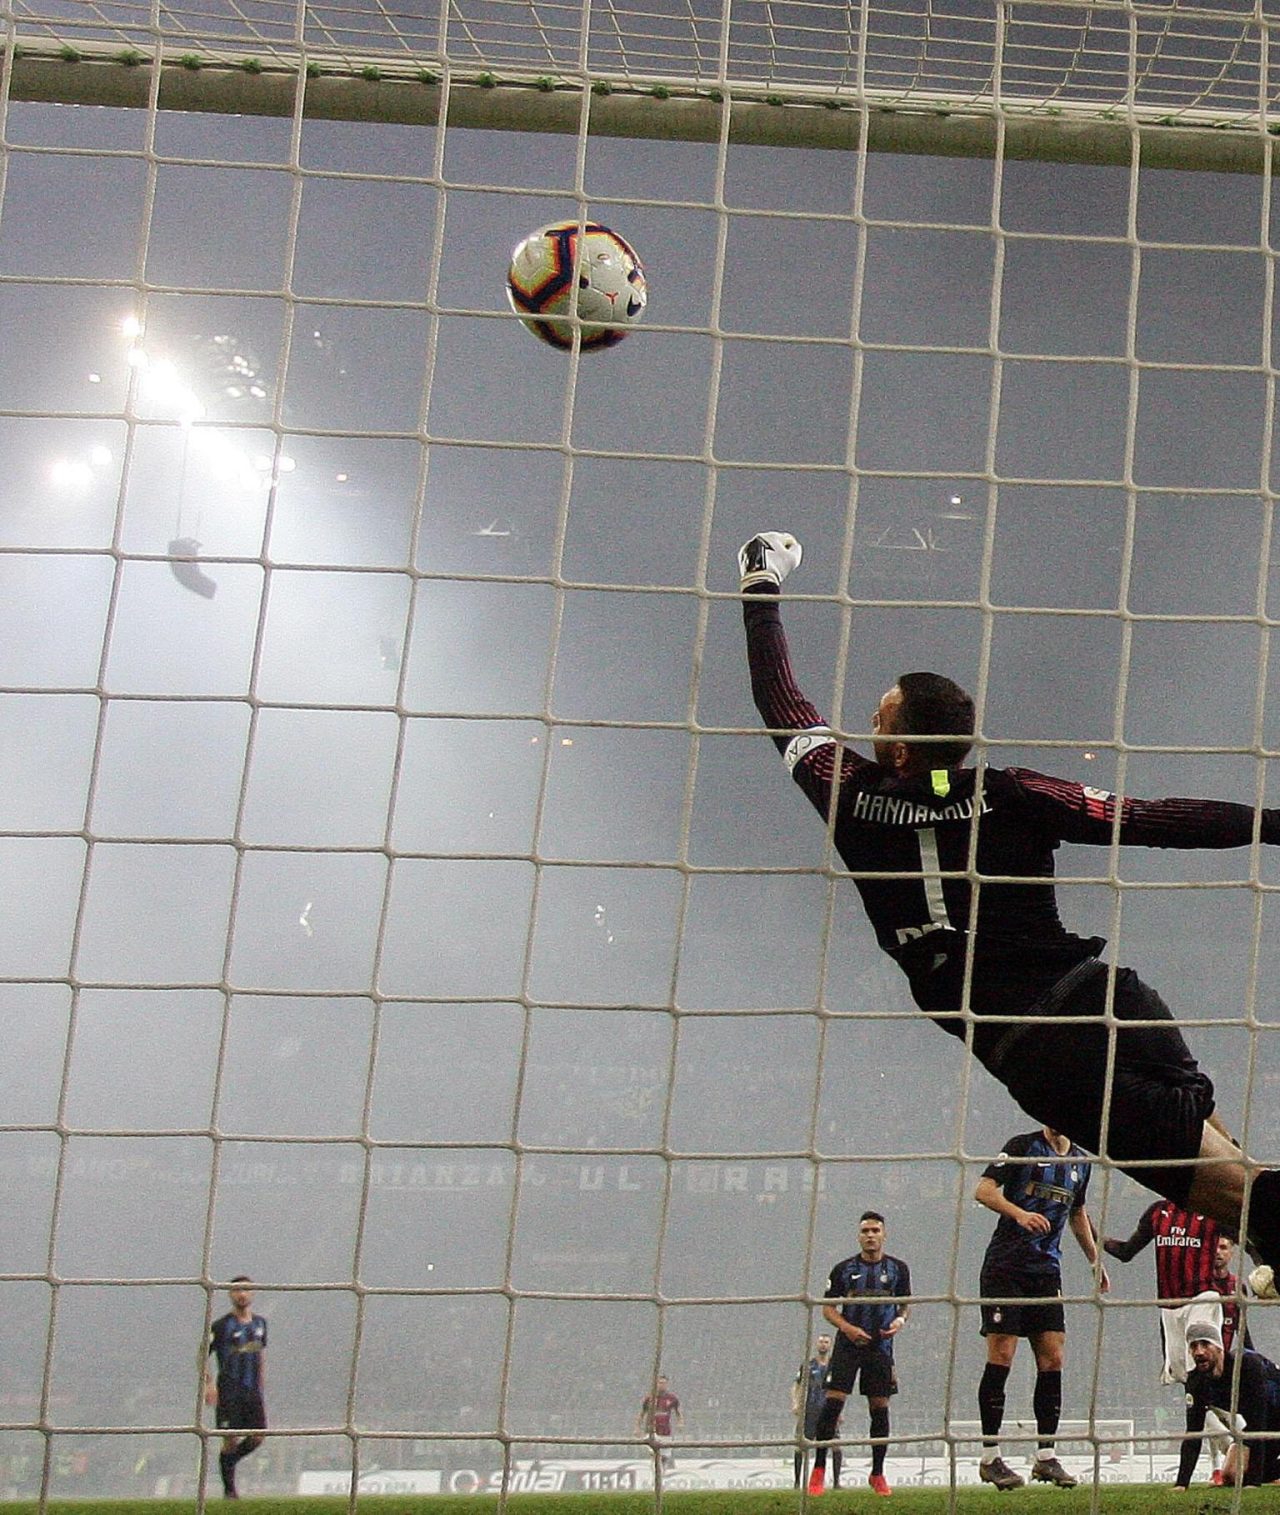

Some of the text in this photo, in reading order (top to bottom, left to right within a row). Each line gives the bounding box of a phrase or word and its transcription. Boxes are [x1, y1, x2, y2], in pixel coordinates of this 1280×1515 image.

[914, 827, 951, 927] 1
[1156, 1234, 1201, 1248] Emirates
[581, 1472, 632, 1490] 11:14
